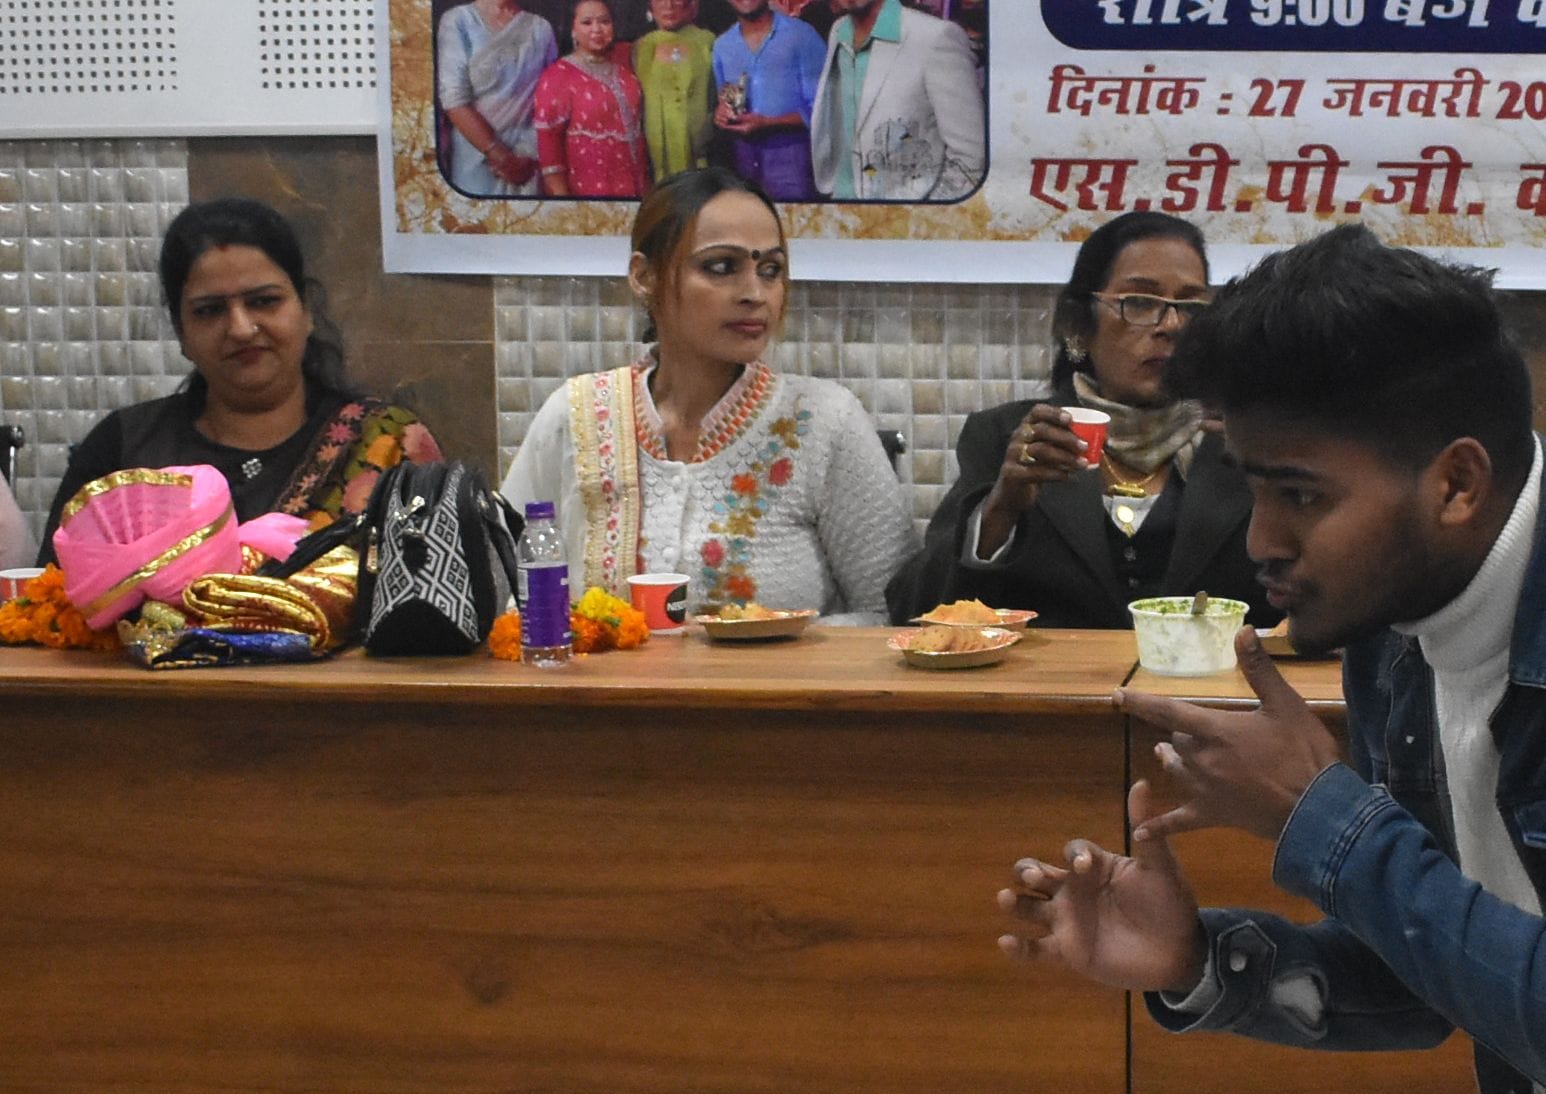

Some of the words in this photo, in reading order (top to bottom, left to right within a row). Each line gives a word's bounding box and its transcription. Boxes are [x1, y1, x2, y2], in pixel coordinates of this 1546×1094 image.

[1047, 64, 1206, 116] दिनांक
[1248, 78, 1306, 118] 27
[1322, 67, 1491, 118] जनवरी
